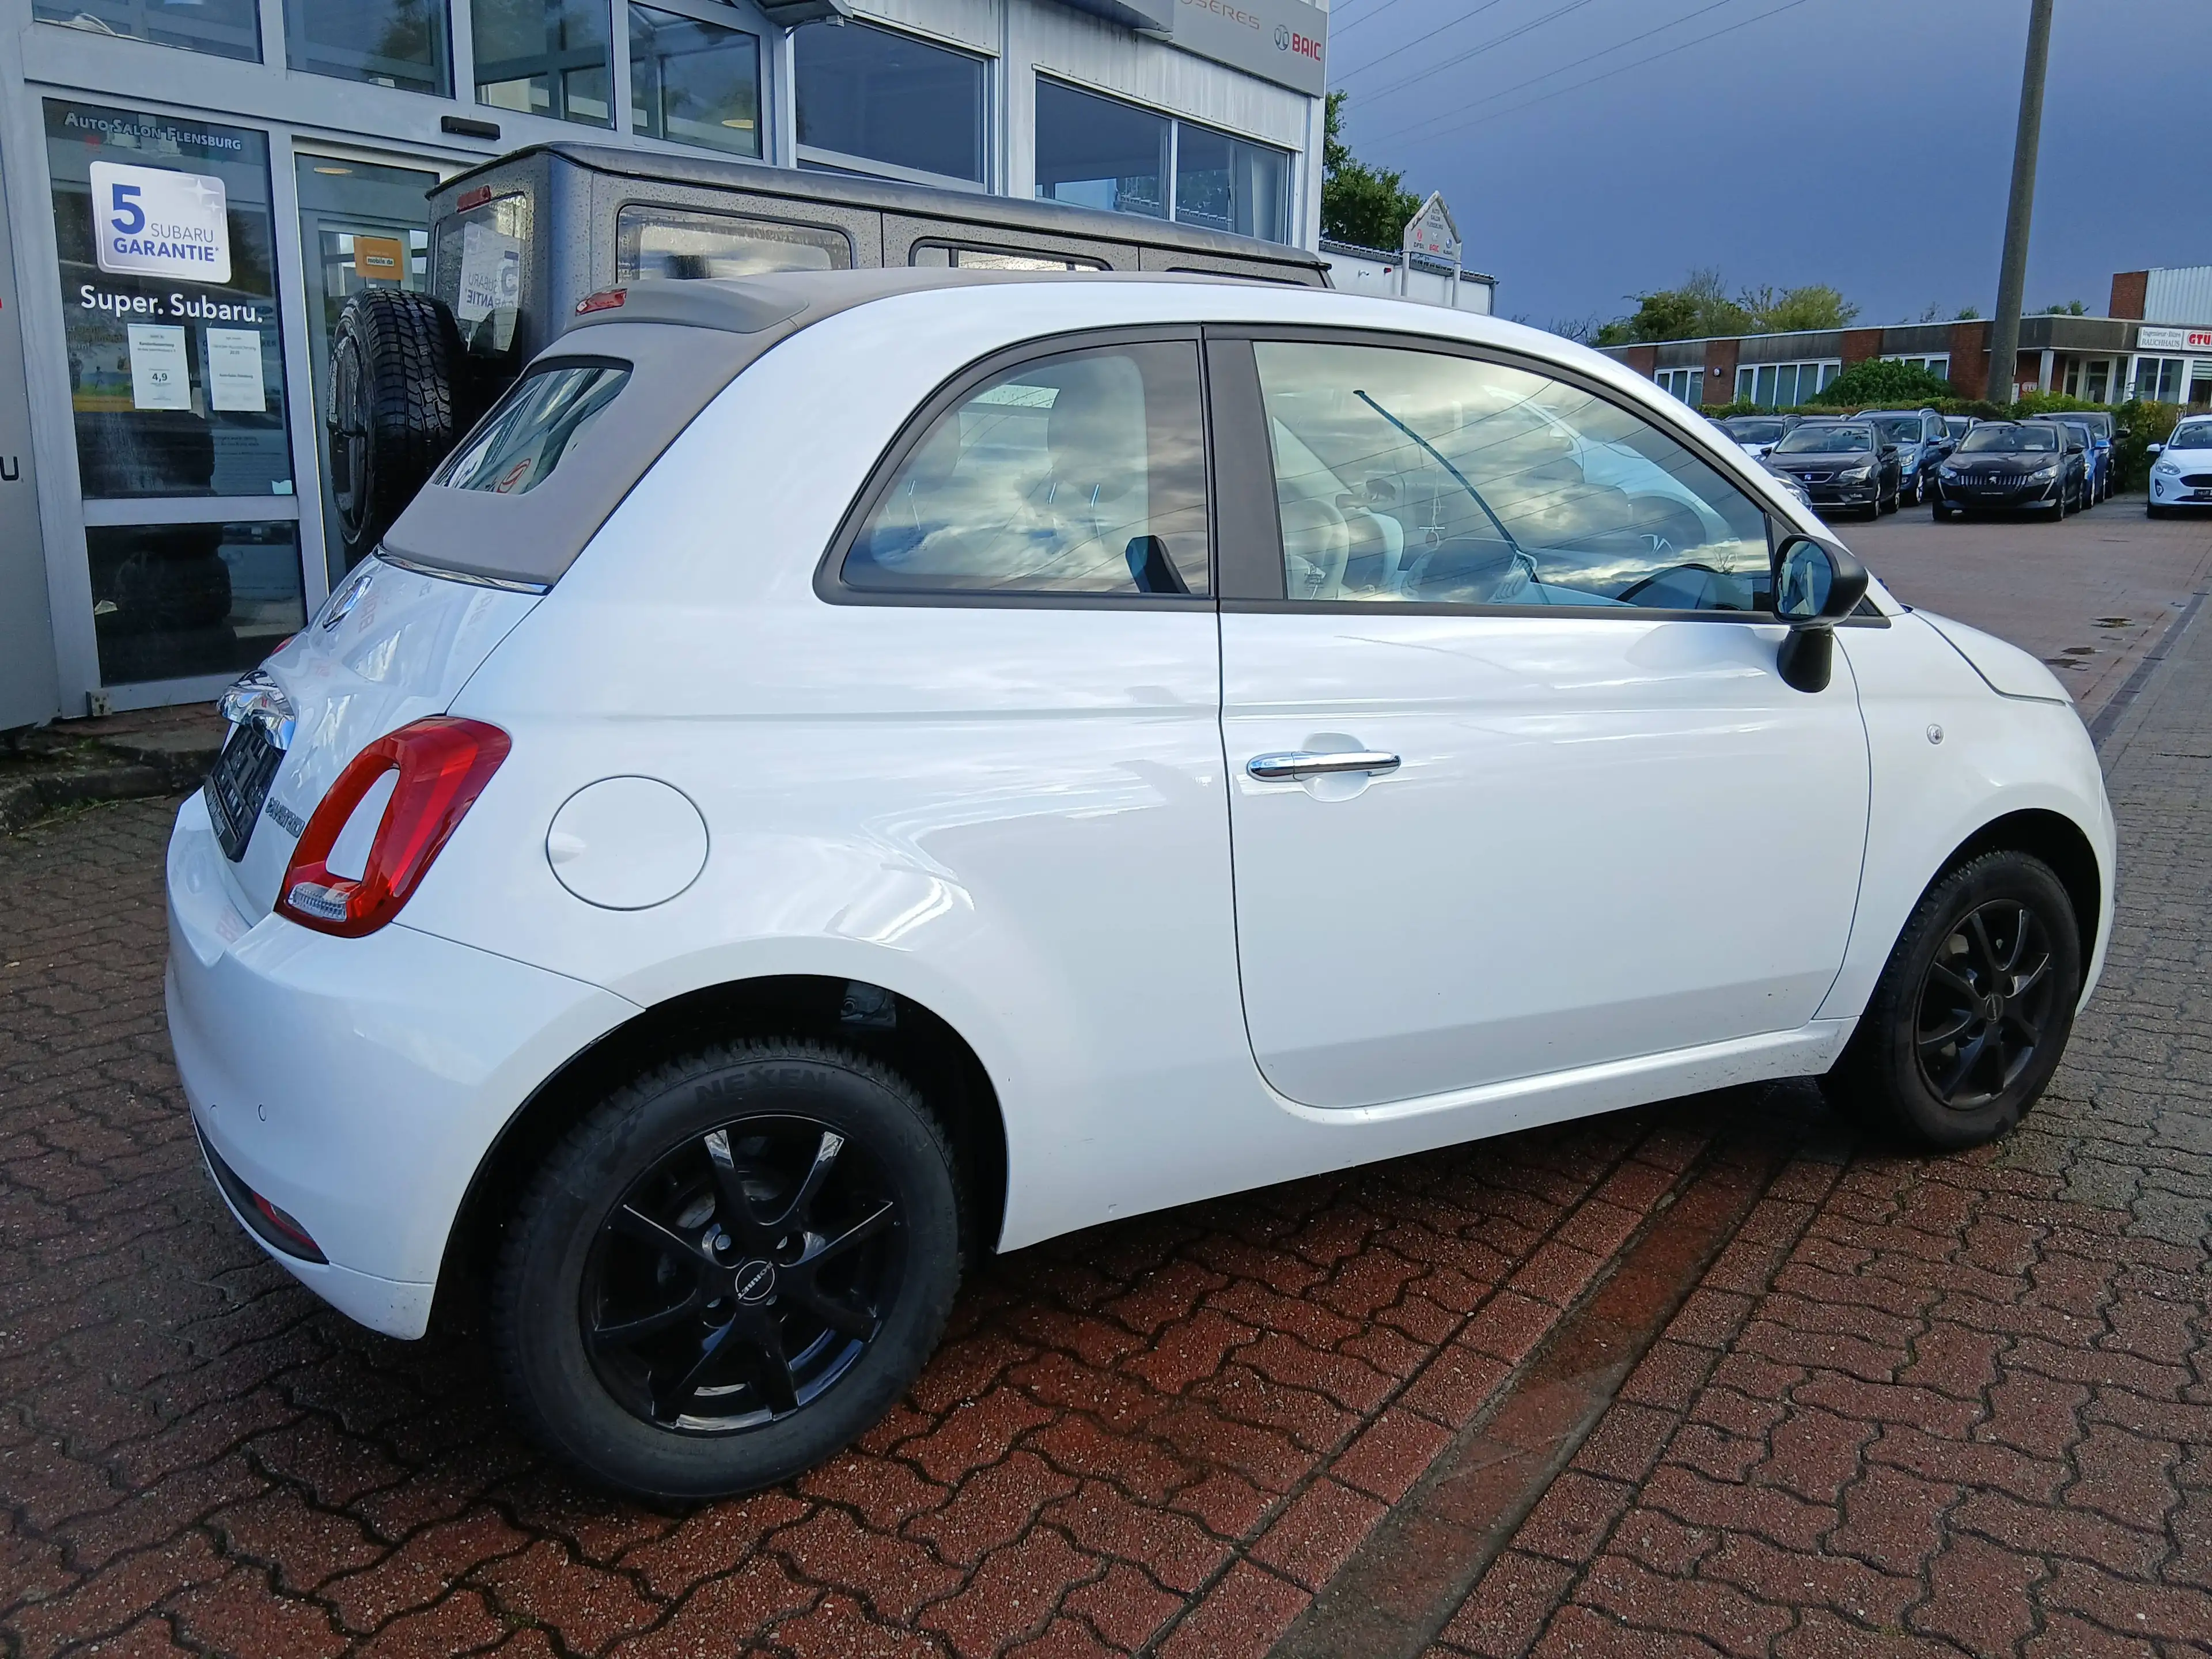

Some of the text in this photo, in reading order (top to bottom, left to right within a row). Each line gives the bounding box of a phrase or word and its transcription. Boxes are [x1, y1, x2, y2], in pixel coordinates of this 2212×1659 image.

[1292, 32, 1321, 62] BAIC
[166, 126, 241, 150] FLENSBURG
[111, 183, 145, 234] 5
[150, 223, 214, 243] SUBARU
[80, 285, 263, 323] Super. Subaru.
[2188, 332, 2211, 346] GTÜ
[152, 373, 168, 382] 4,9
[695, 1066, 827, 1103] NEXEN
